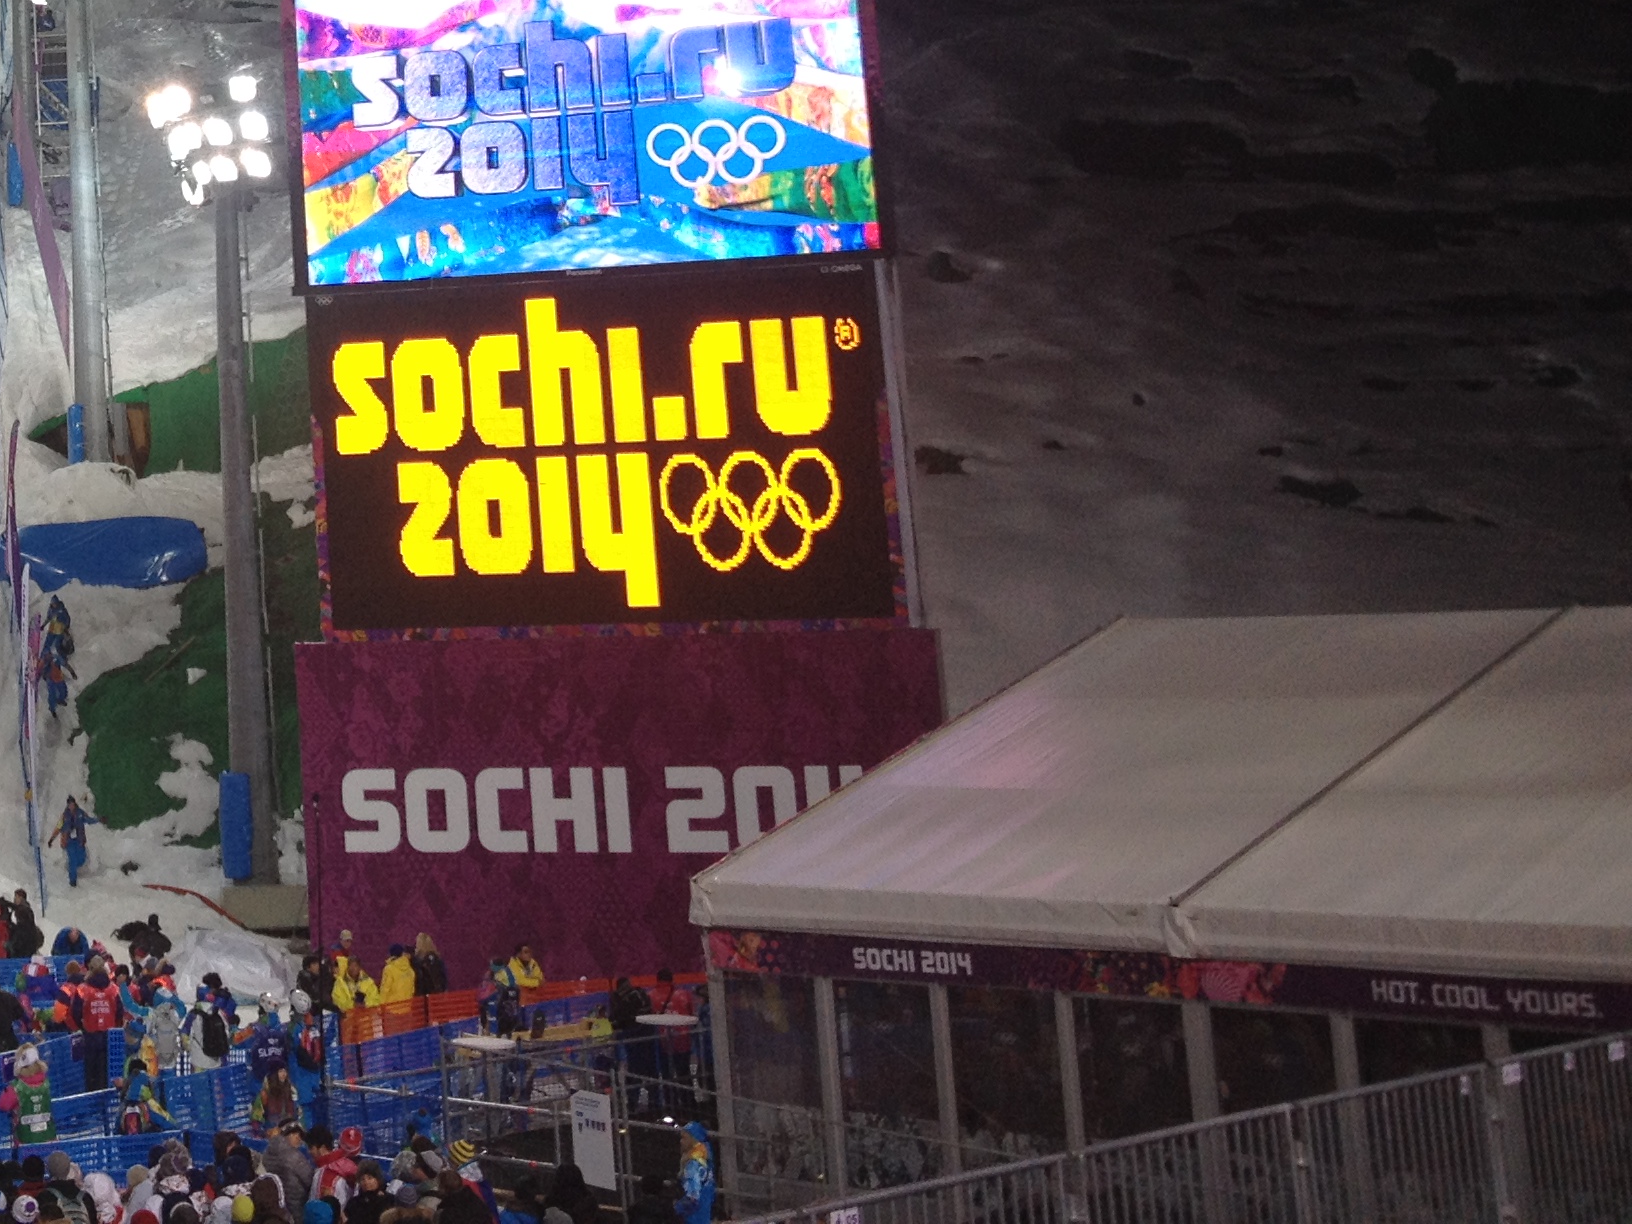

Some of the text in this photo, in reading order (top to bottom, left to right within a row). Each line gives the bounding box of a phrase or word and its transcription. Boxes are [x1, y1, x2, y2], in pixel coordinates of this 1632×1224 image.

[352, 17, 796, 128] sochi.ru
[406, 106, 640, 206] 2014
[333, 297, 832, 454] sochi.ru
[396, 452, 660, 607] 2014
[341, 765, 864, 853] SOCHI 20
[852, 947, 972, 976] SOCHI 2014
[1371, 979, 1426, 1005] HOT.
[1506, 988, 1604, 1019] YOURS.
